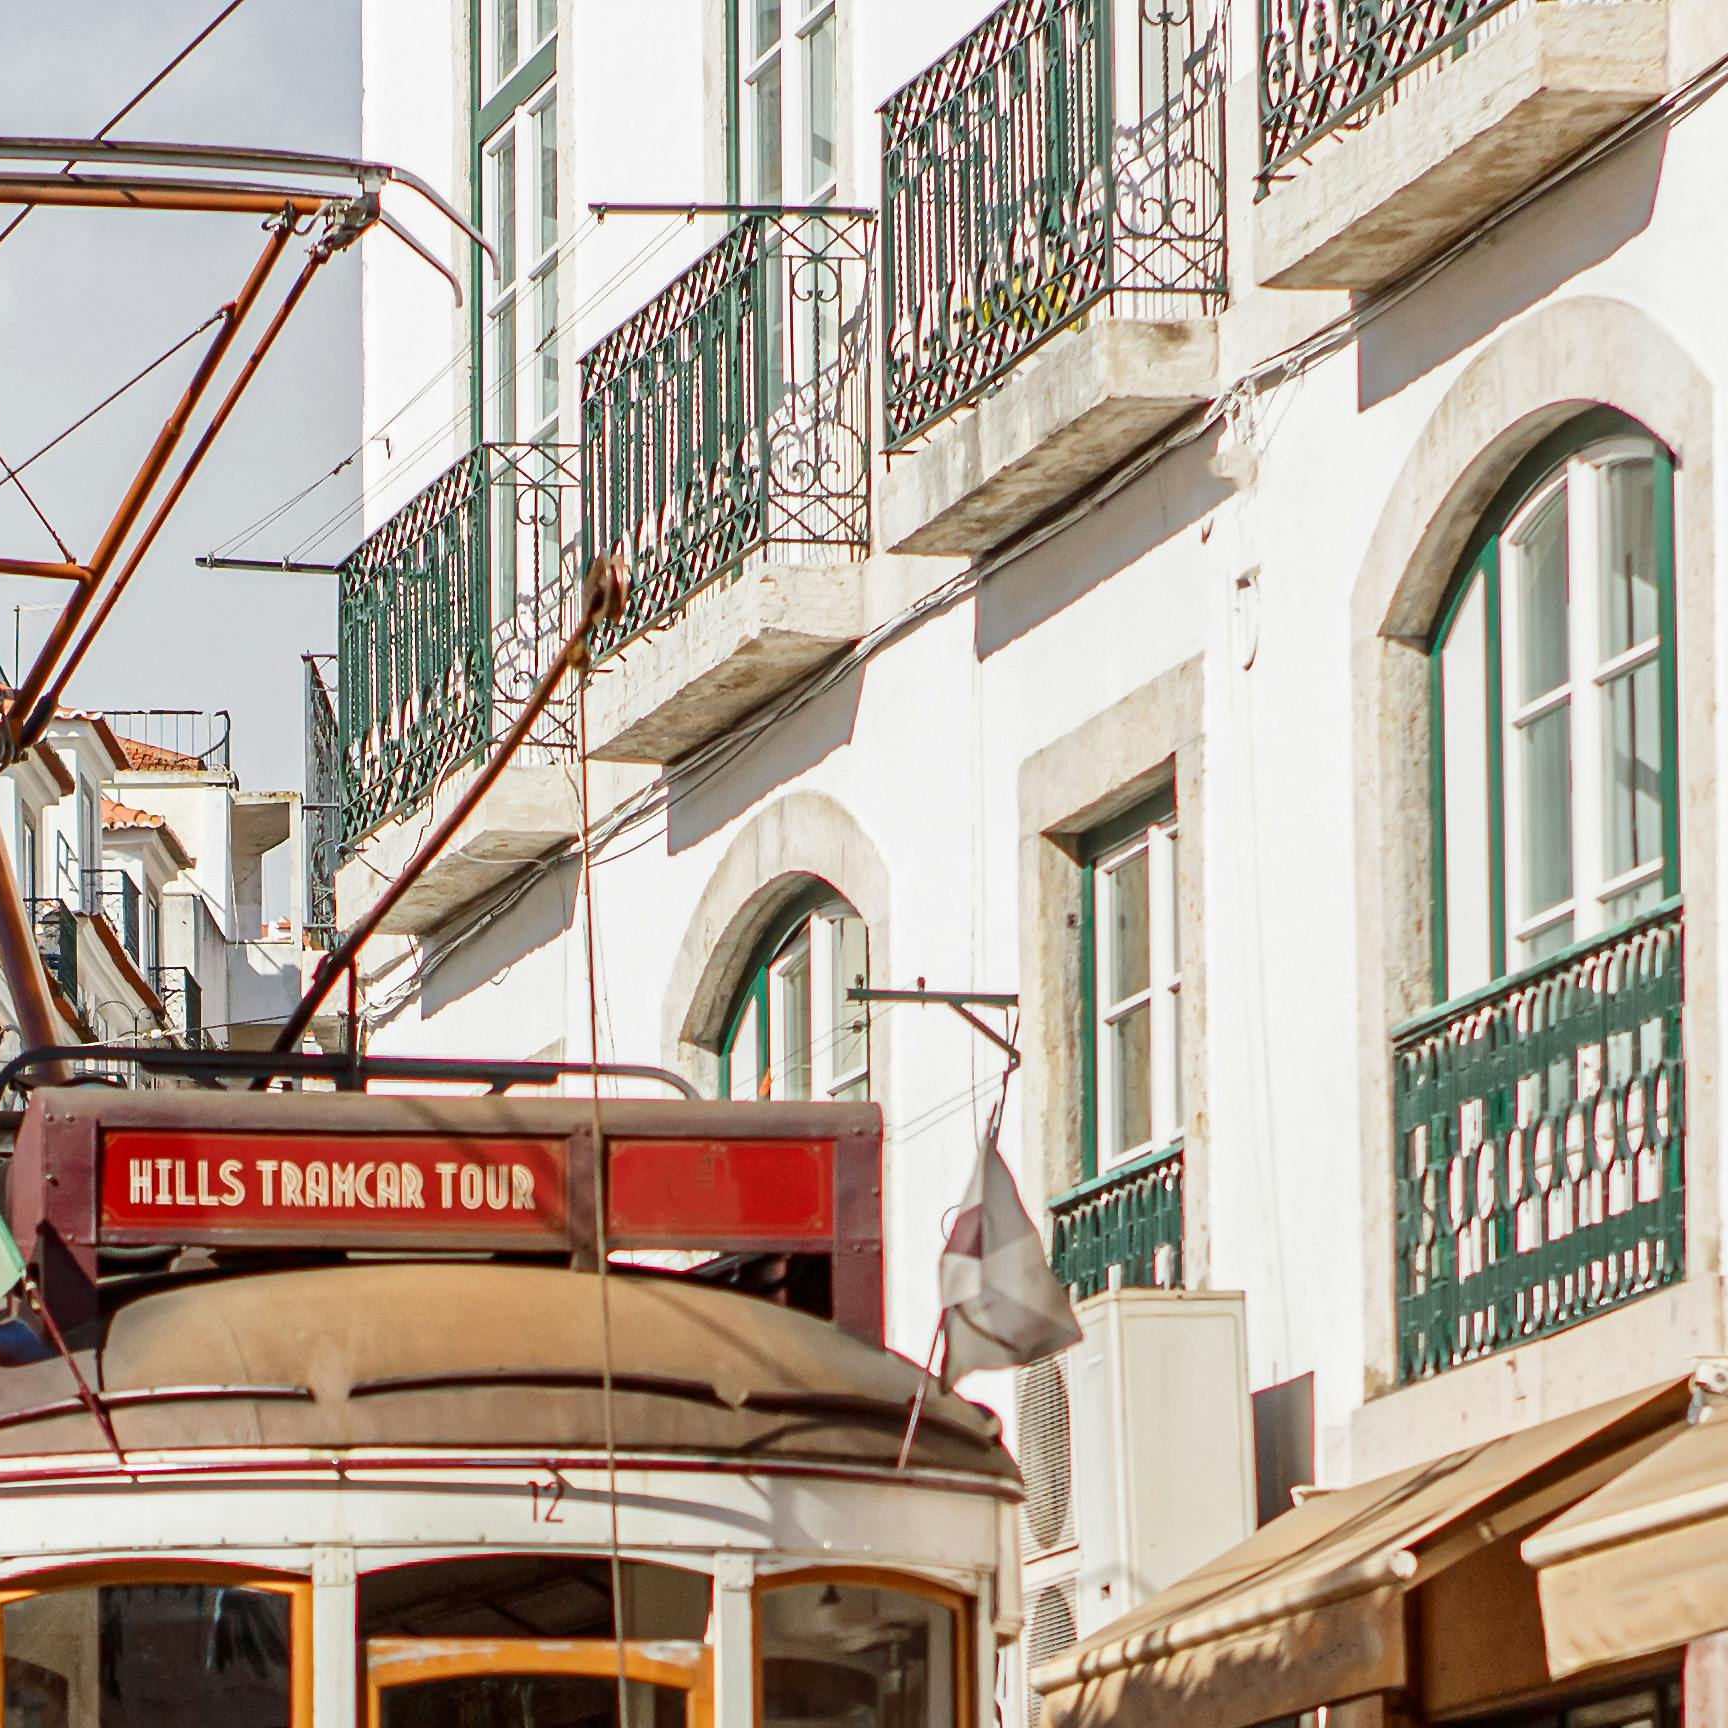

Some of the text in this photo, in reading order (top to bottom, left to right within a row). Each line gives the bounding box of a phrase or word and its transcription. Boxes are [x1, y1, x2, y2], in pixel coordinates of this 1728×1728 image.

[129, 1158, 536, 1211] HILLS TRAMCAR TOUR
[527, 1480, 564, 1523] 12
